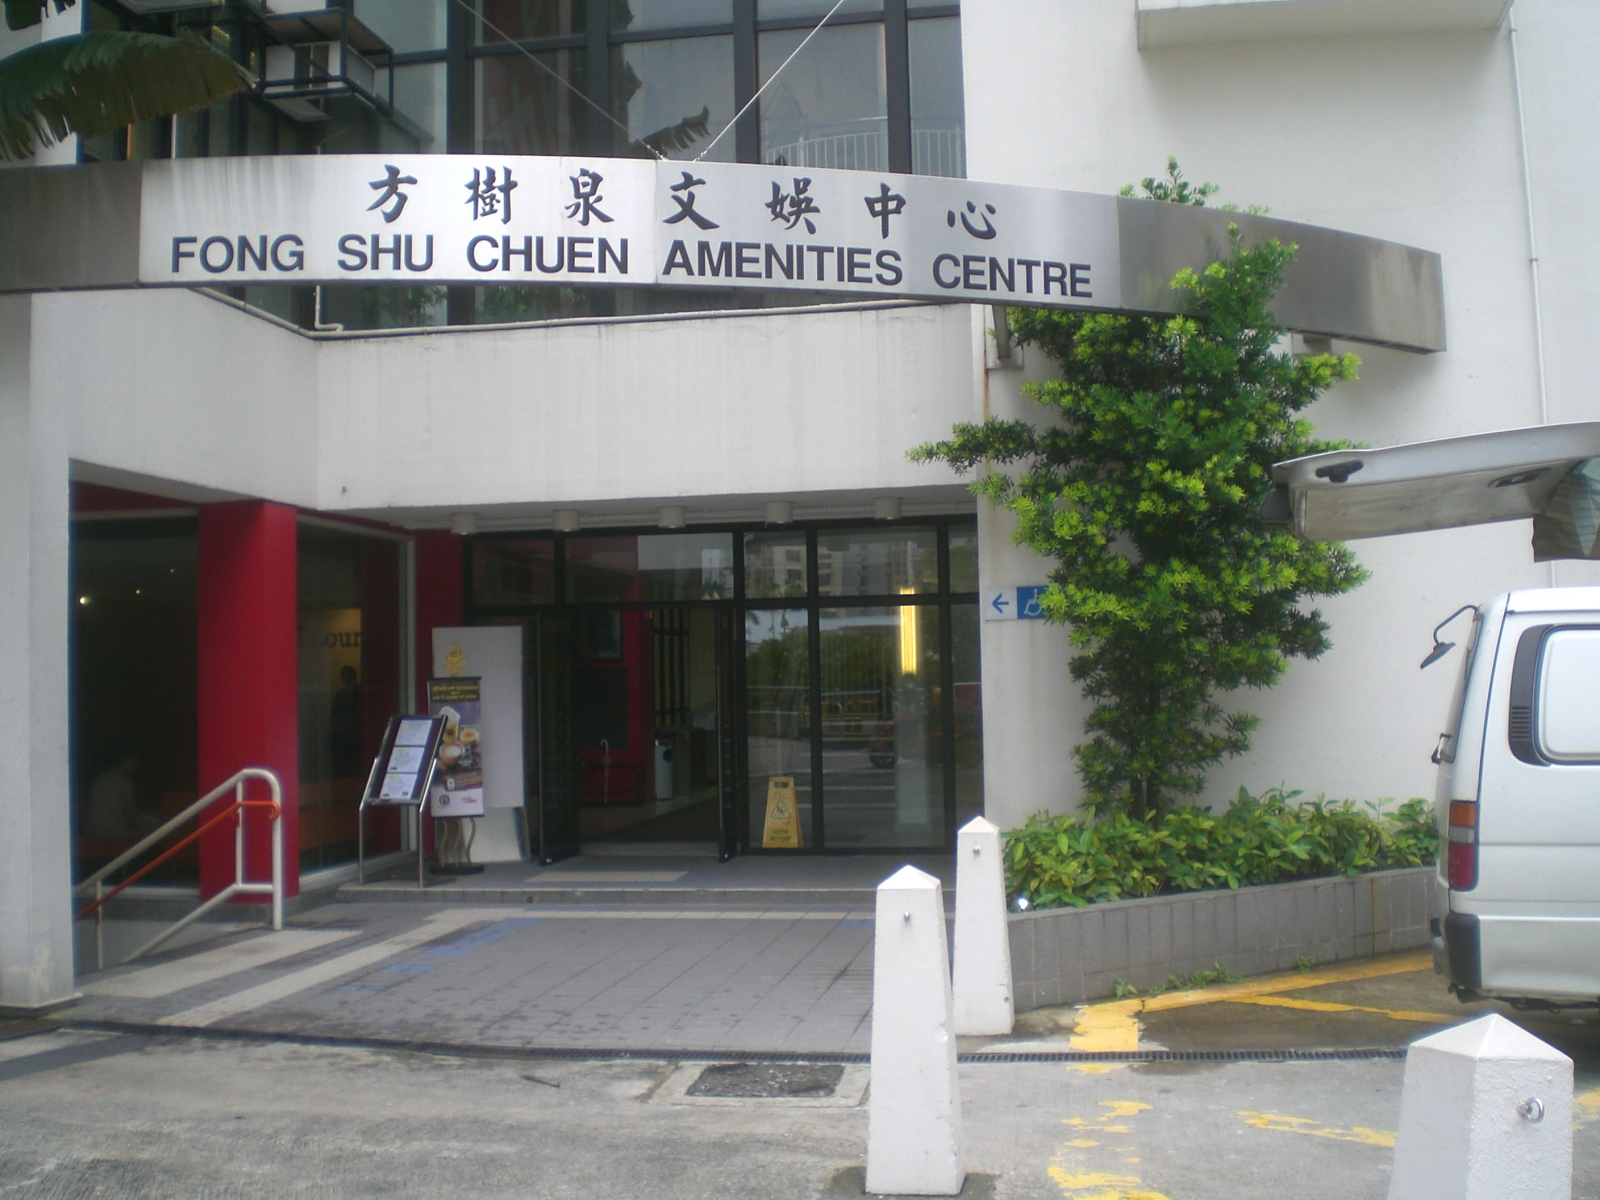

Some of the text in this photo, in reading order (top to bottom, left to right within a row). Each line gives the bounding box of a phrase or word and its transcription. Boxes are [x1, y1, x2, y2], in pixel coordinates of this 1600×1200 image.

[171, 233, 1093, 298] FONG SHU CHUEN AMENITIES CENTRE
